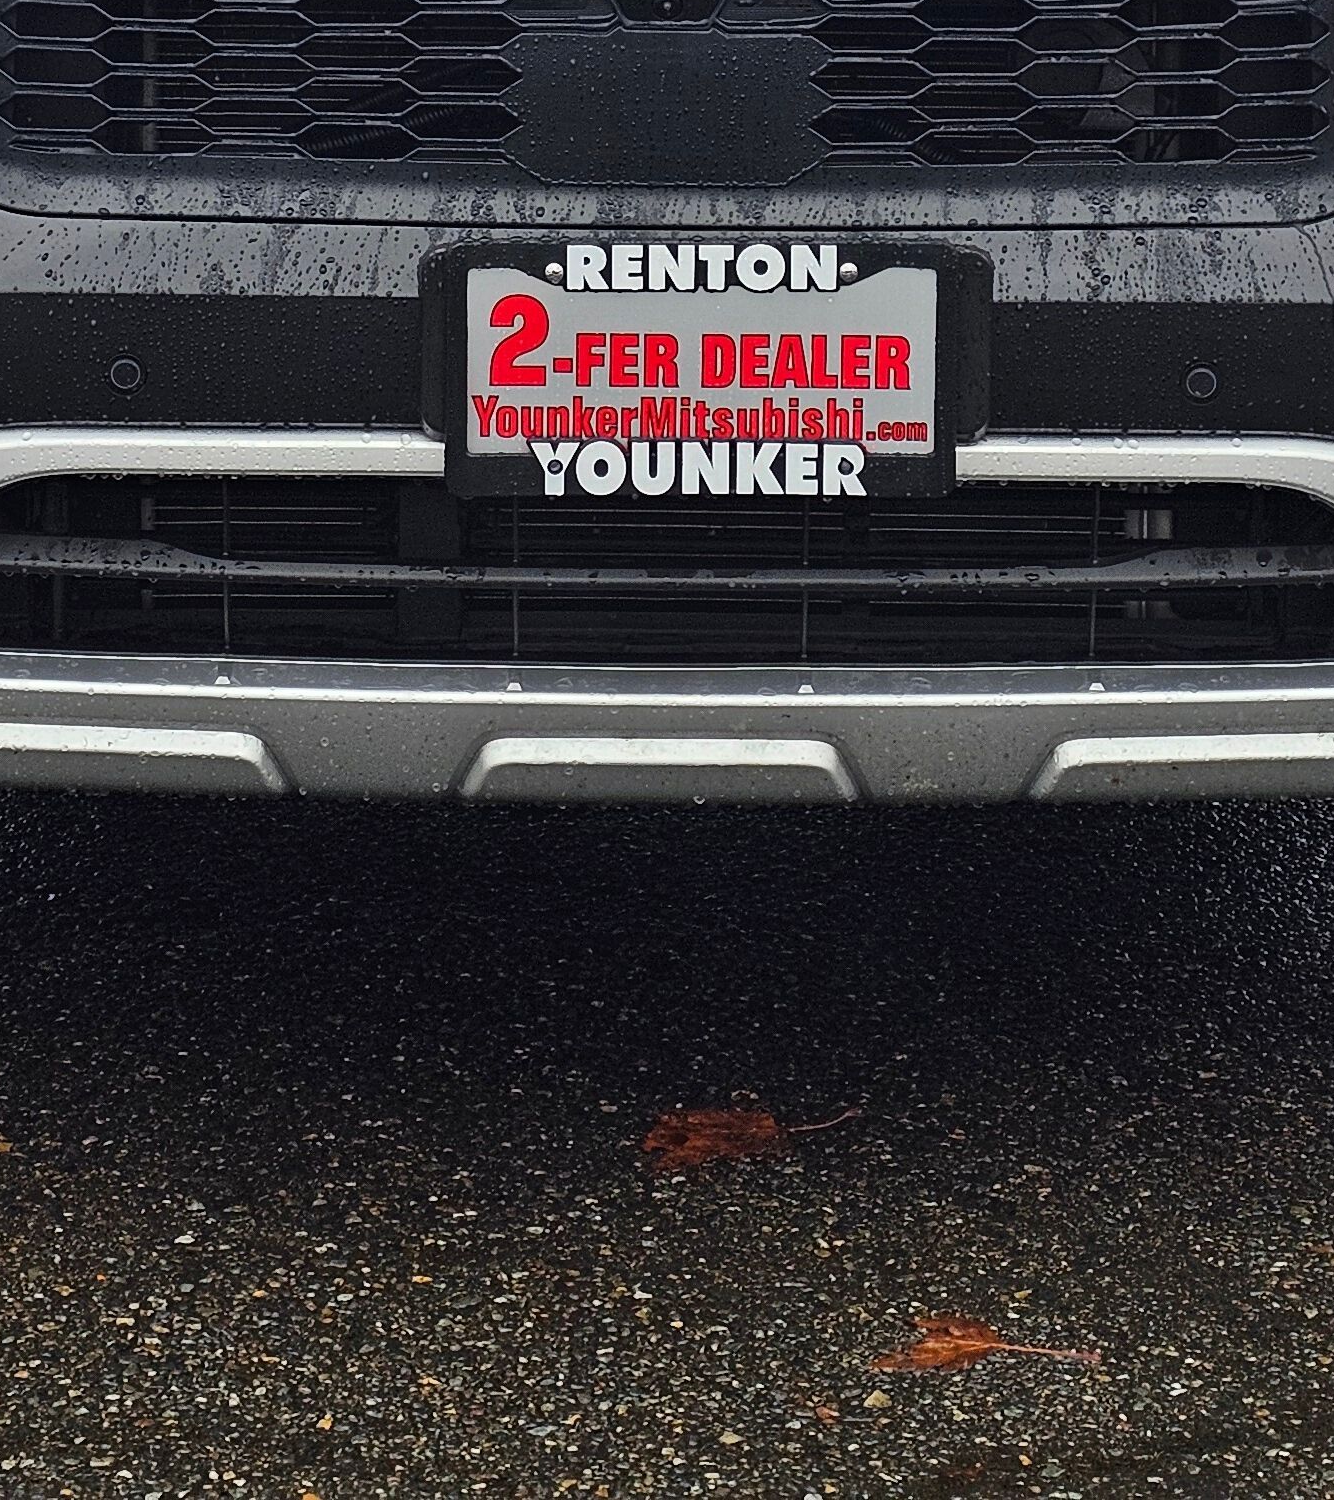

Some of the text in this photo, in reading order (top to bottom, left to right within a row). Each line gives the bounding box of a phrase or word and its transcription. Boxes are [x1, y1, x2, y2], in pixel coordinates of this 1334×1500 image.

[565, 243, 839, 292] RENTON
[488, 293, 912, 391] 2-FER DEALER
[470, 394, 930, 444] YounkerMitsubishi.com
[530, 441, 868, 497] YOUNKER
